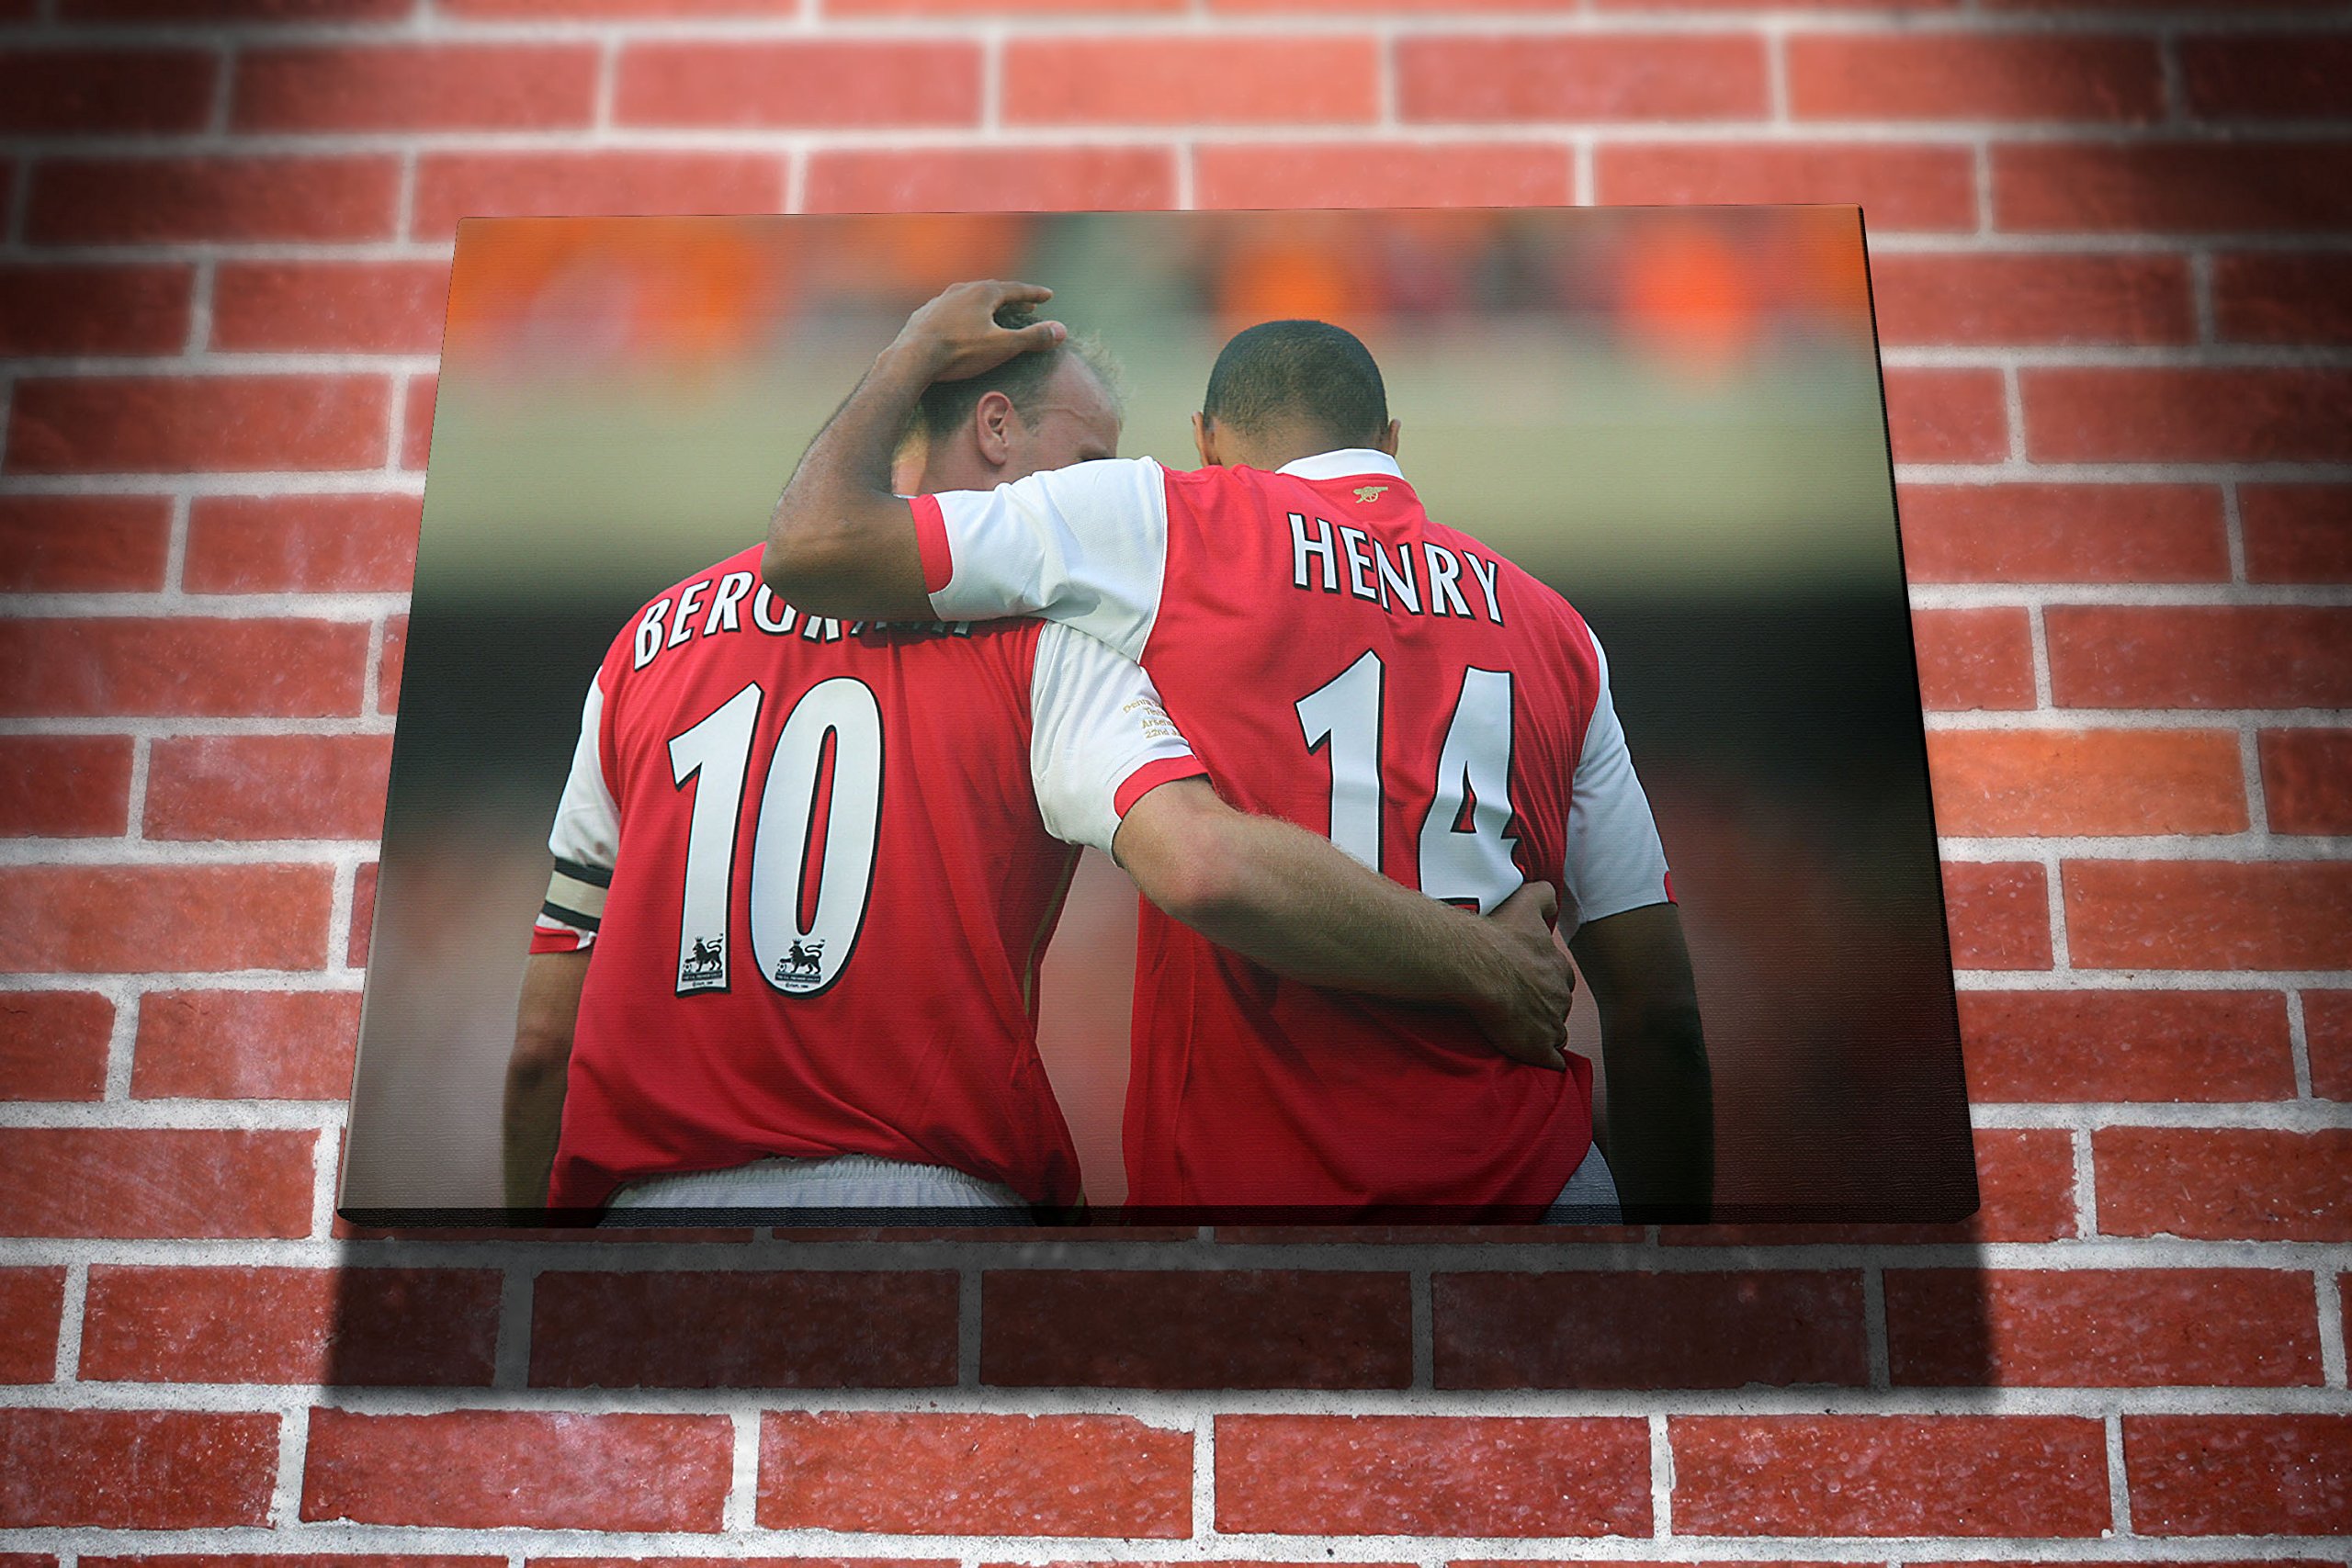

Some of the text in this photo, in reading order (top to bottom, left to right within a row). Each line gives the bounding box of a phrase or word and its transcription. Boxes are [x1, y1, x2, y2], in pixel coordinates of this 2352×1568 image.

[633, 570, 973, 671] BERG
[1288, 512, 1504, 626] HENRY
[668, 676, 886, 999] 10
[1295, 649, 1525, 916] 14
